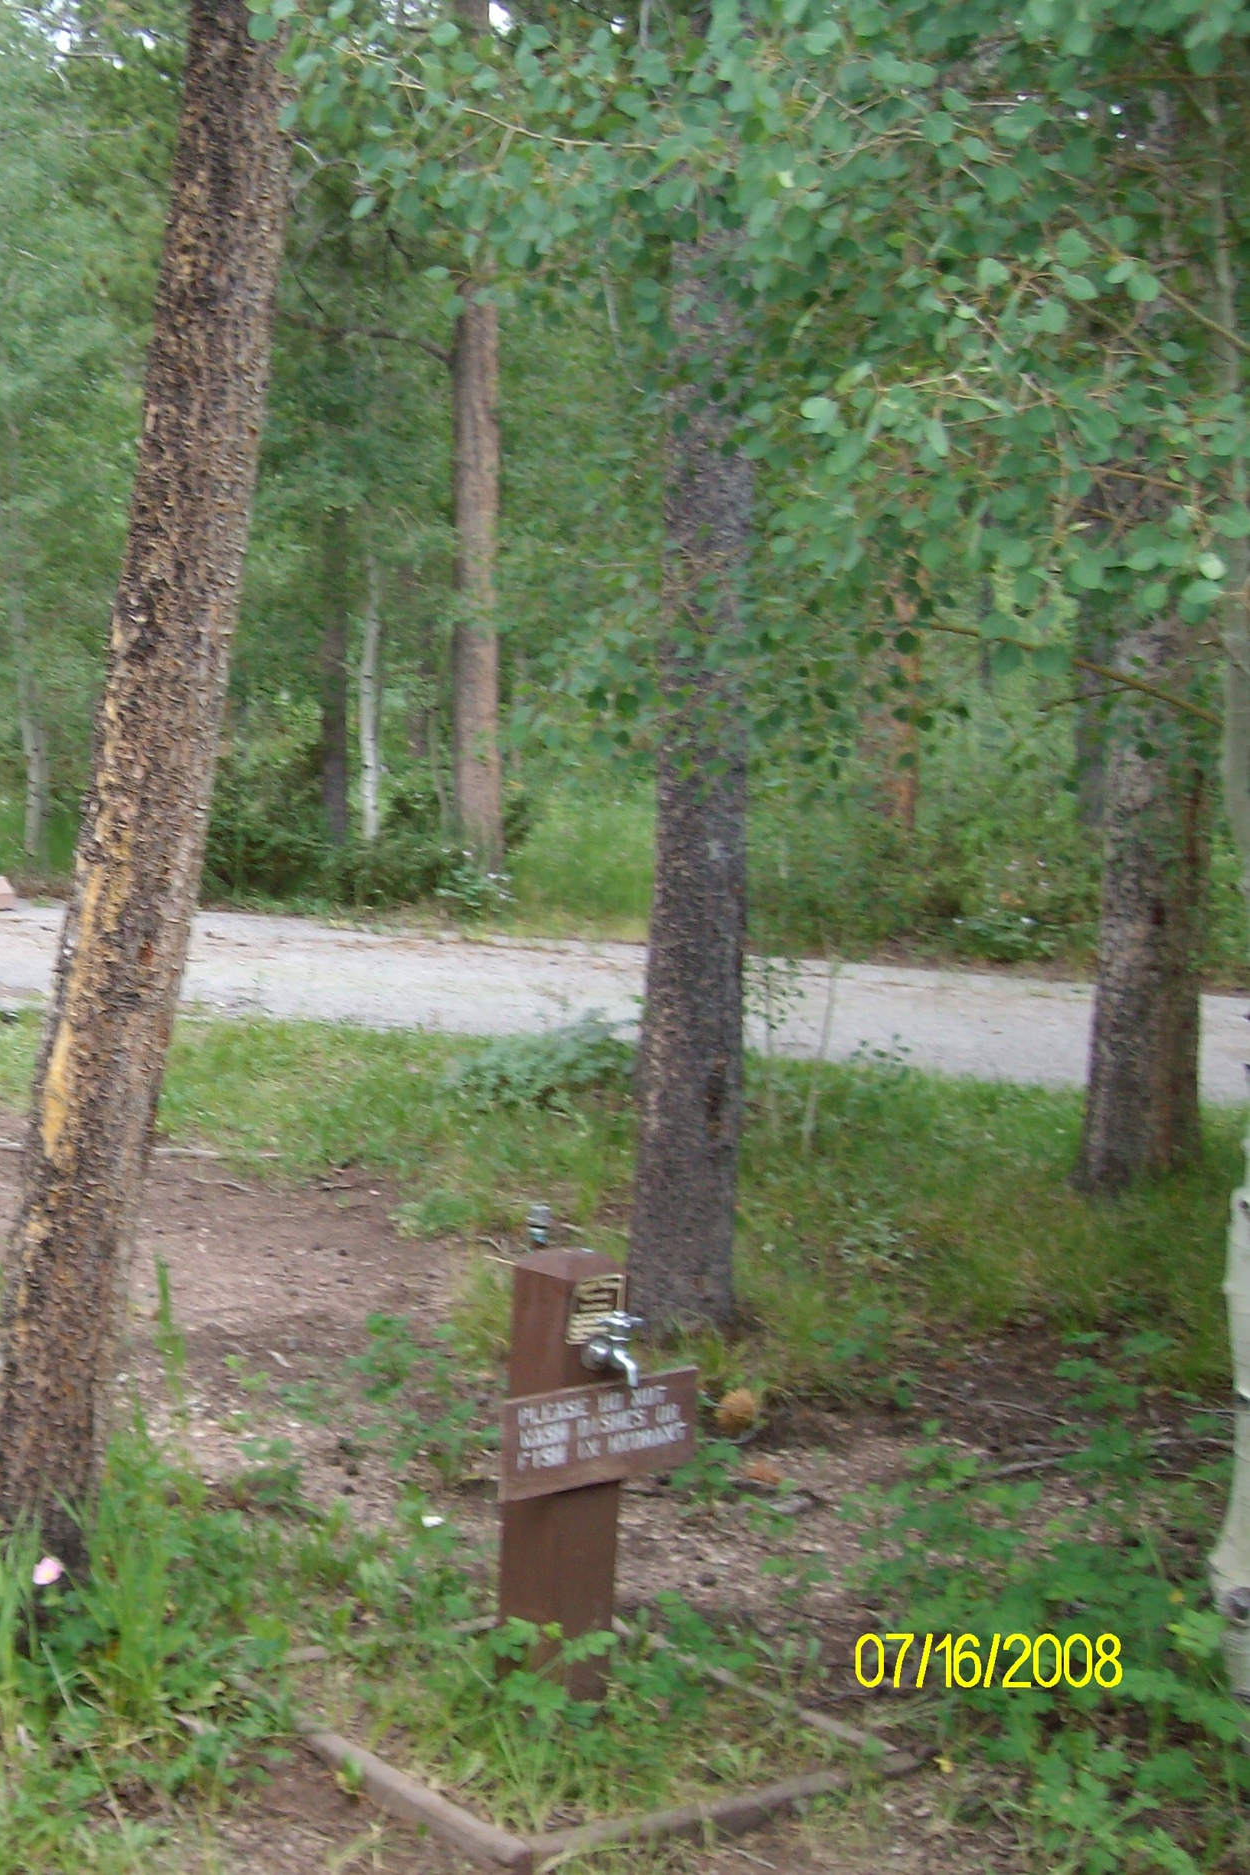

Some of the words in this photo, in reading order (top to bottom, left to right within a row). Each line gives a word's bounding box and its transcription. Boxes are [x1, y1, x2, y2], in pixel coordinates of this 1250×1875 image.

[517, 1397, 589, 1427] PLEASE
[598, 1391, 625, 1413] DO
[631, 1385, 668, 1408] NOT
[519, 1422, 569, 1449] WASH
[576, 1408, 648, 1438] DISHES
[655, 1403, 681, 1425] OR
[516, 1444, 568, 1470] FISH
[576, 1439, 600, 1460] IN
[607, 1421, 689, 1454] HYDRANT
